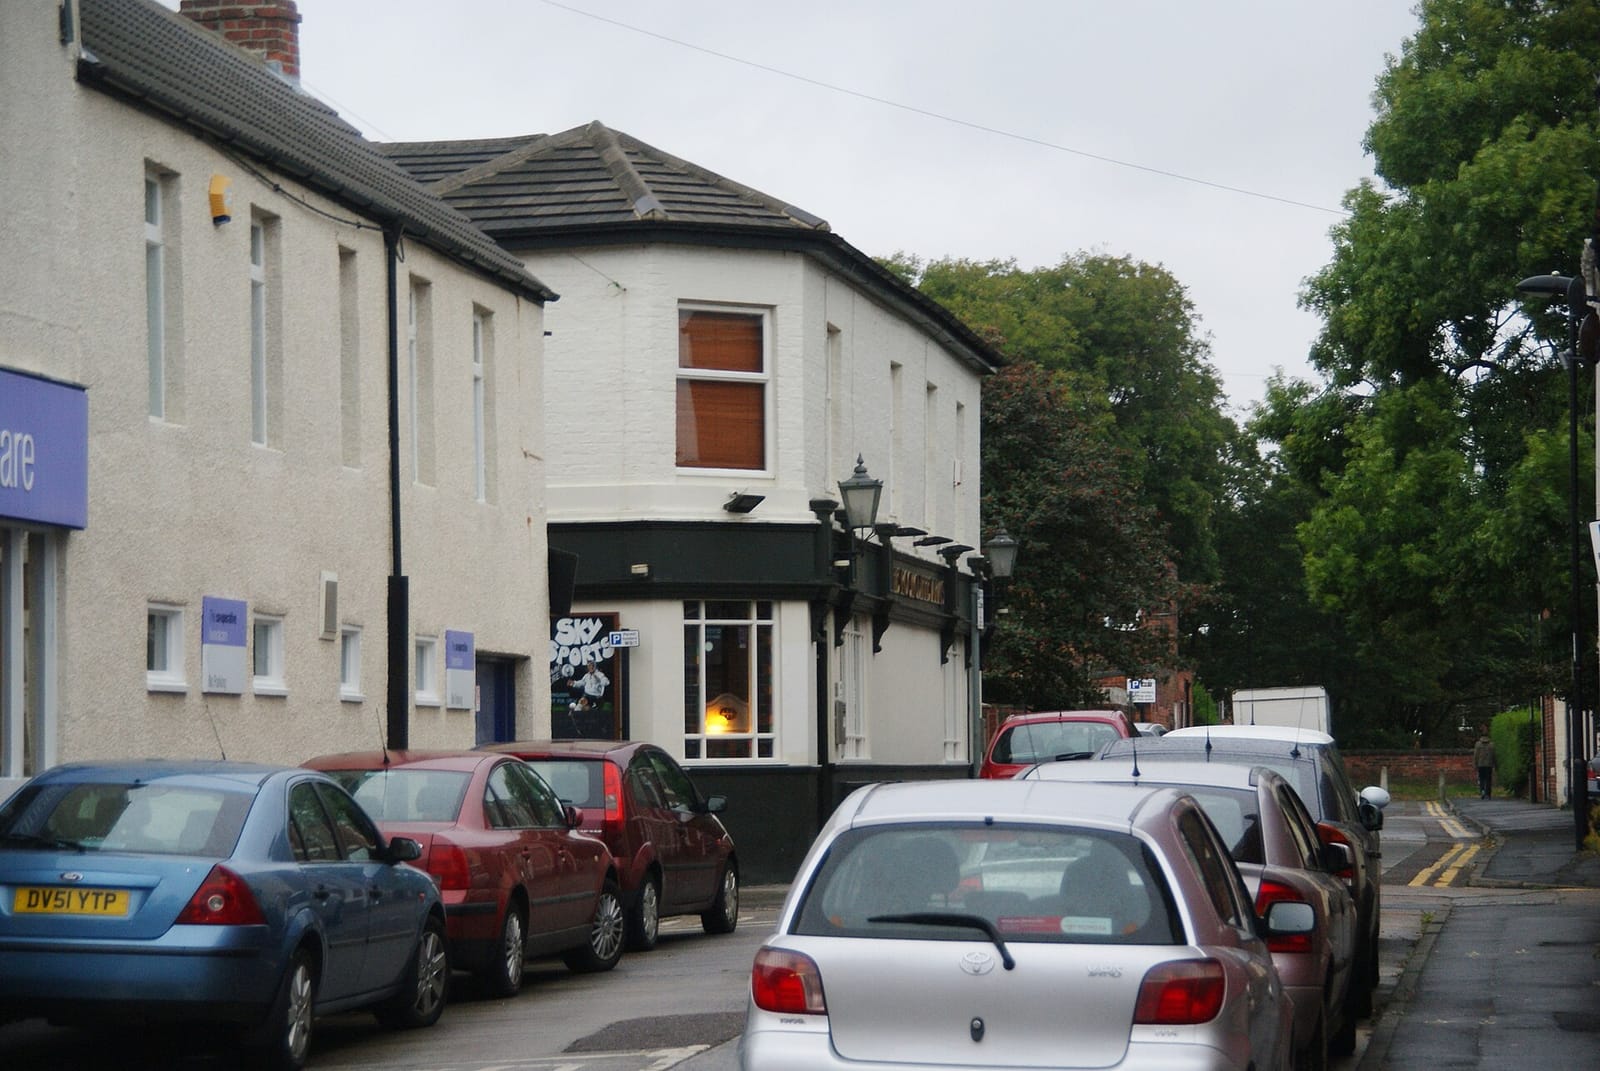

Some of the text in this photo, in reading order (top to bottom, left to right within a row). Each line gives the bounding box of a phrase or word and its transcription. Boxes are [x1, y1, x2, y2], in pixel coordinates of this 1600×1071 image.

[0, 430, 35, 491] are
[555, 618, 602, 646] SKY
[613, 634, 621, 645] P
[549, 636, 615, 666] SPORTS
[1132, 680, 1139, 689] P
[27, 889, 117, 910] DV51 YTP
